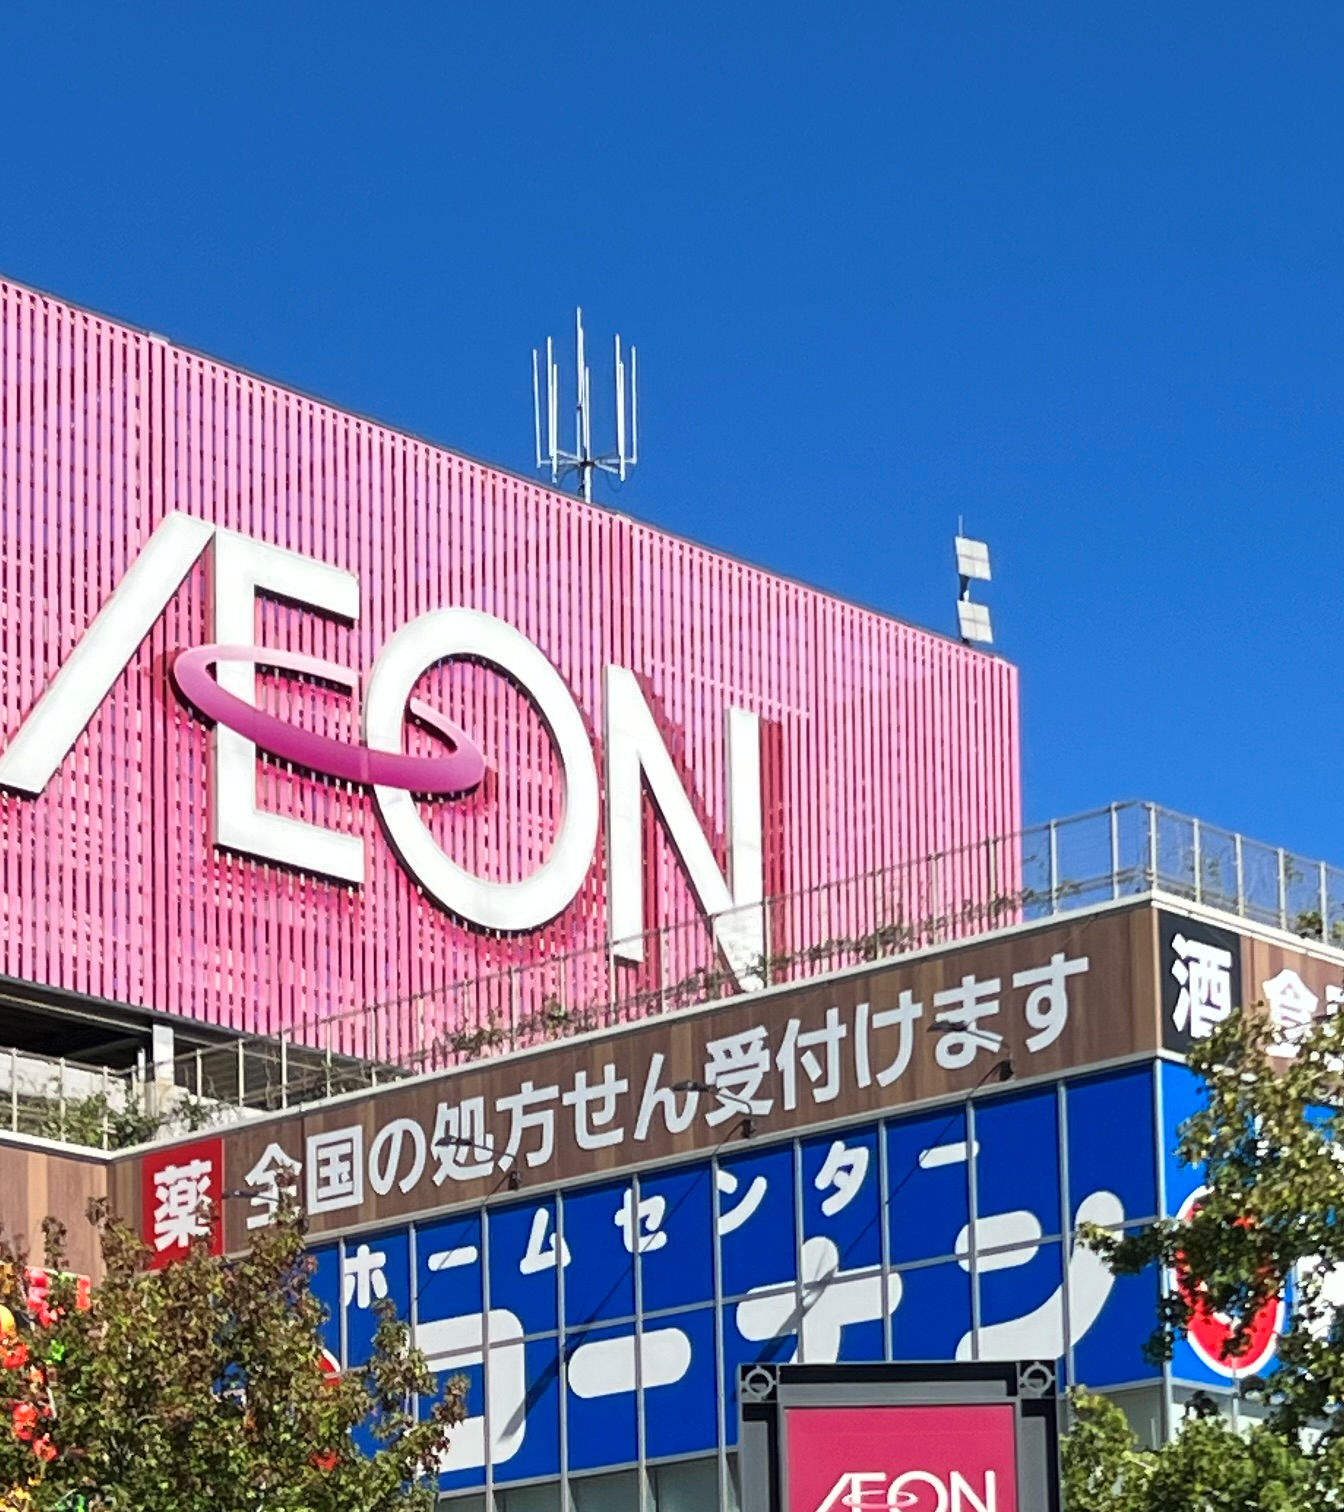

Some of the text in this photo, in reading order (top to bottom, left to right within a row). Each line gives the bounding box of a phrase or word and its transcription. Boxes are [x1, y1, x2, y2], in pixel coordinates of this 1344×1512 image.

[1172, 933, 1234, 1039] 酒
[245, 953, 1089, 1231] 全国の処方せん受付けます
[154, 1159, 212, 1253] 薬
[342, 1139, 980, 1308] ホームセンター
